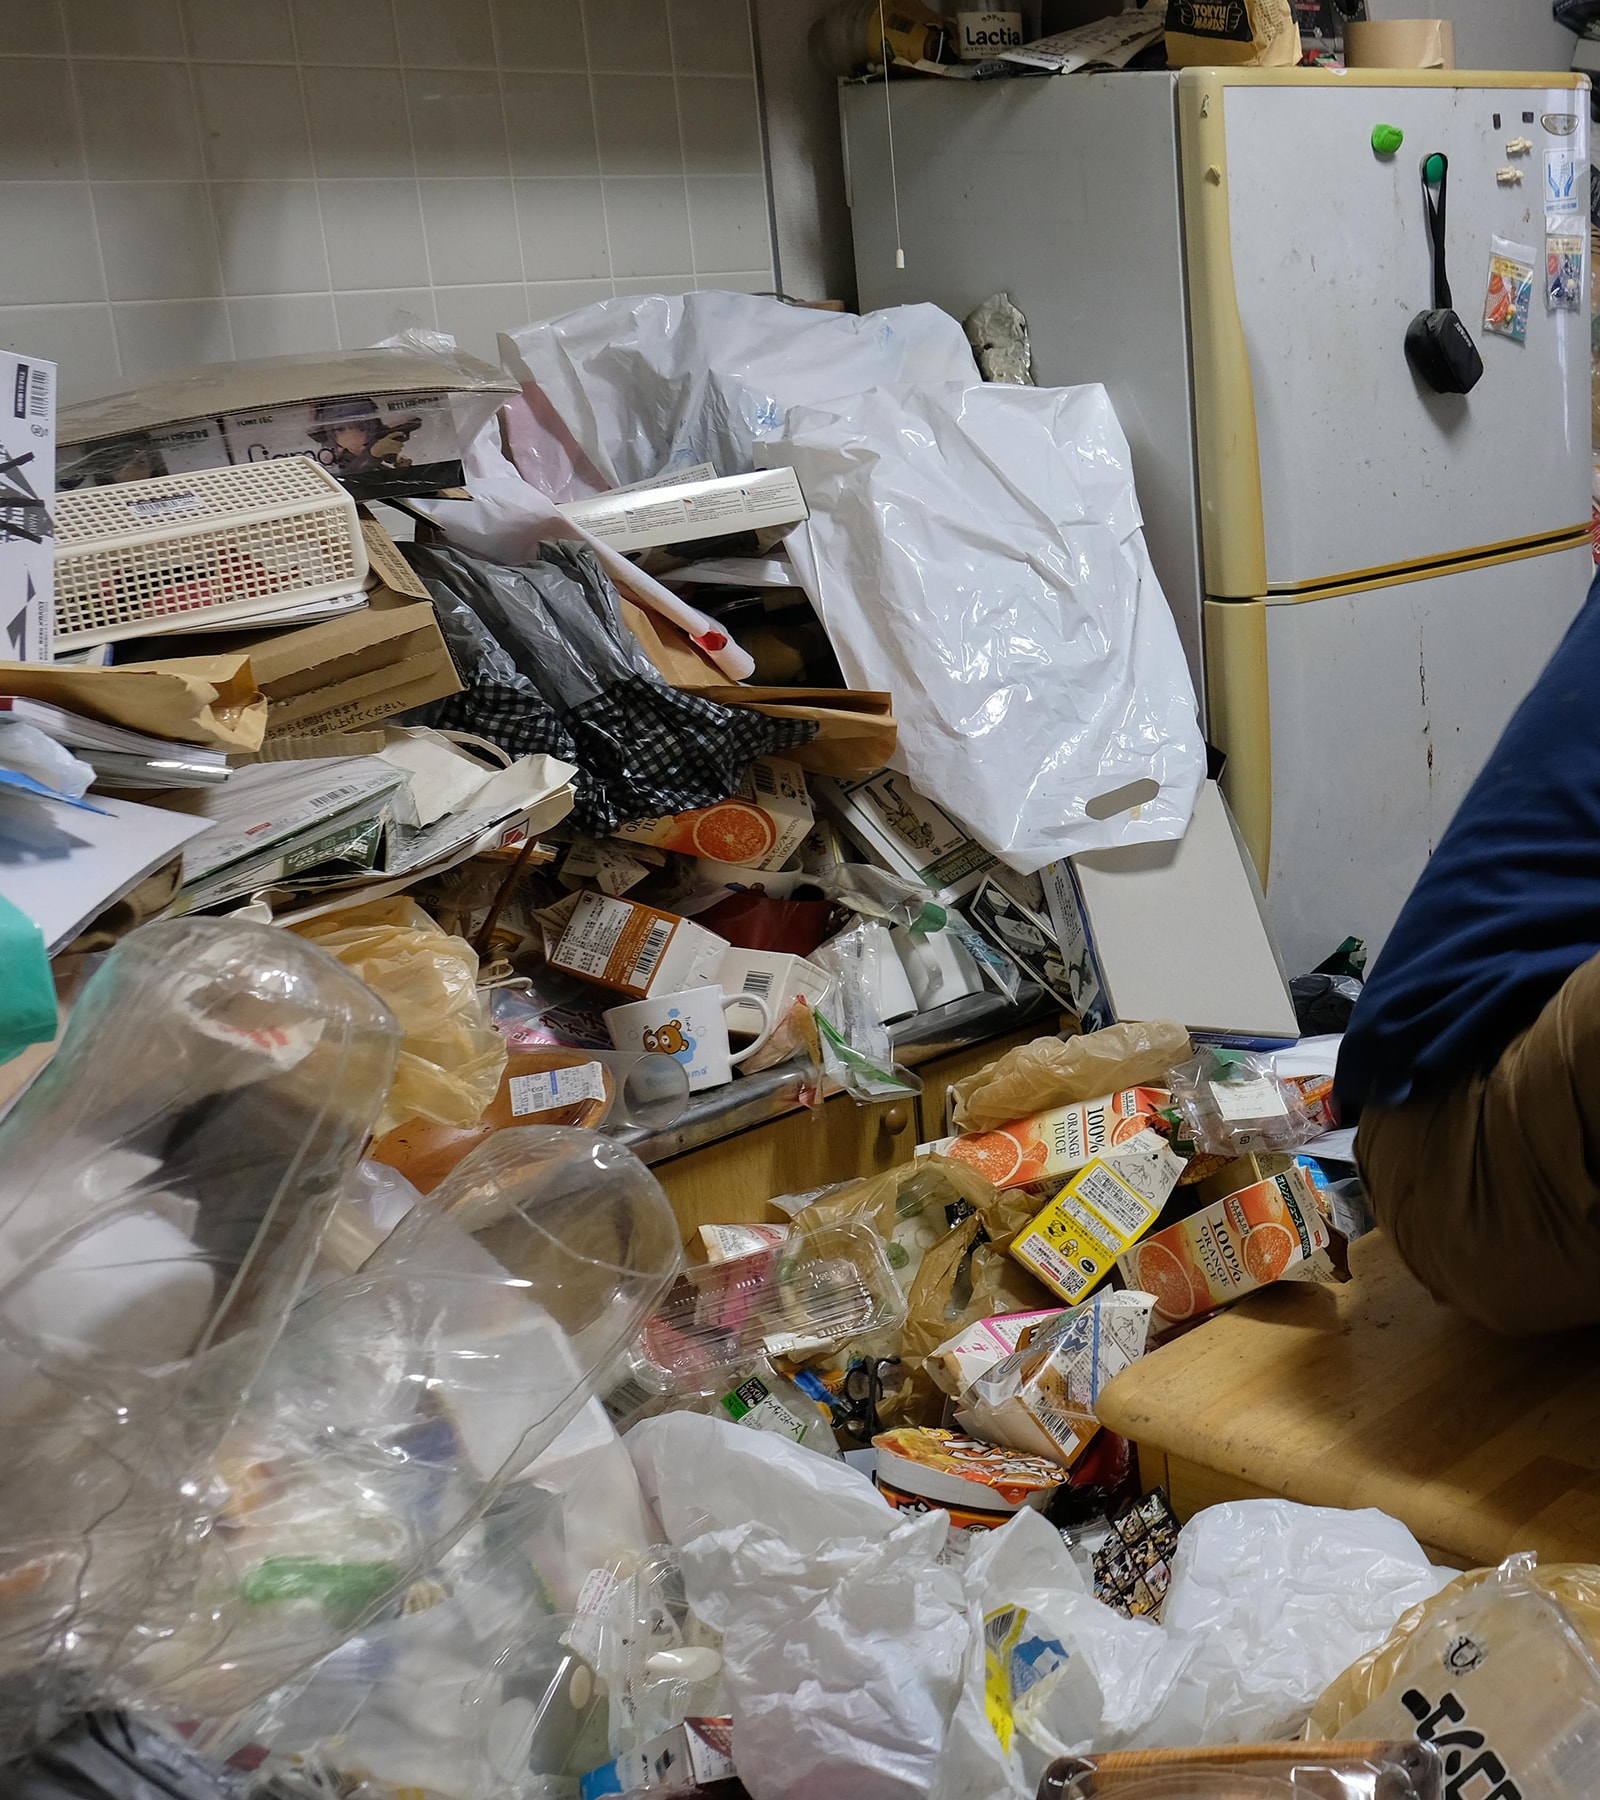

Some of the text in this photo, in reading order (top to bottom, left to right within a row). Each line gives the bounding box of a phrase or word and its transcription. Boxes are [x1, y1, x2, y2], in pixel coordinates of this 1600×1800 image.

[1193, 4, 1226, 19] TOKYU
[966, 26, 1021, 46] Lactia
[1125, 1089, 1136, 1118] LAWSON
[1053, 1120, 1065, 1155] JUICE
[1066, 1112, 1081, 1159] ORANGE
[1087, 1105, 1105, 1154] 100%
[1231, 1198, 1251, 1236] LAWSON
[1275, 1175, 1302, 1230] オレンジジュース
[1194, 1237, 1219, 1283] JUICE
[1200, 1225, 1230, 1288] ORANGE
[1212, 1217, 1244, 1283] 100%
